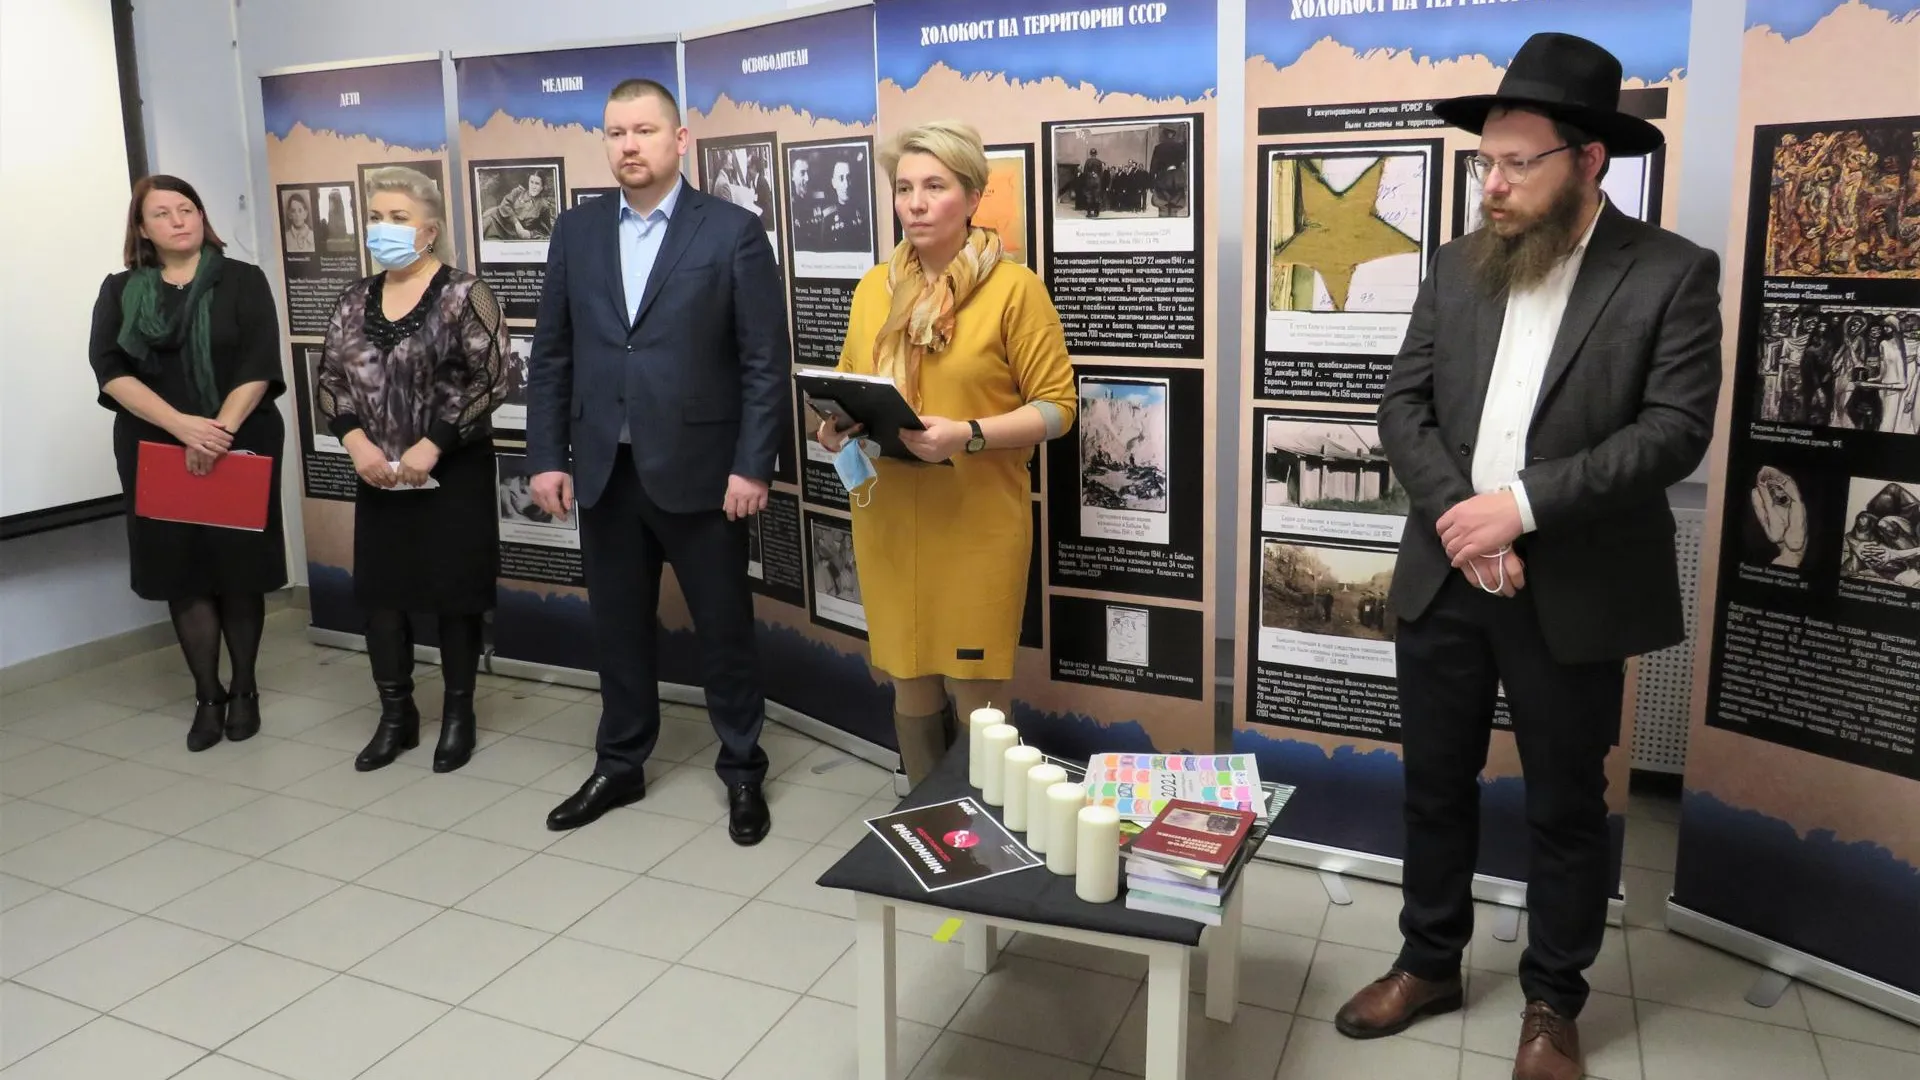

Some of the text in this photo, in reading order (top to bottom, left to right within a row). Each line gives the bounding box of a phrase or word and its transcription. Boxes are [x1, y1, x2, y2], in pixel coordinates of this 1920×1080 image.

[920, 3, 1167, 46] ХОЛОКОСТ НА ТЕРРИТОРИИ СССР
[742, 48, 808, 74] ОСВОБОДИТЕЛИ
[542, 76, 583, 93] МЕДИКИ
[340, 92, 360, 108] ДЕТИ
[891, 824, 946, 874] #МЫПОМНИМ
